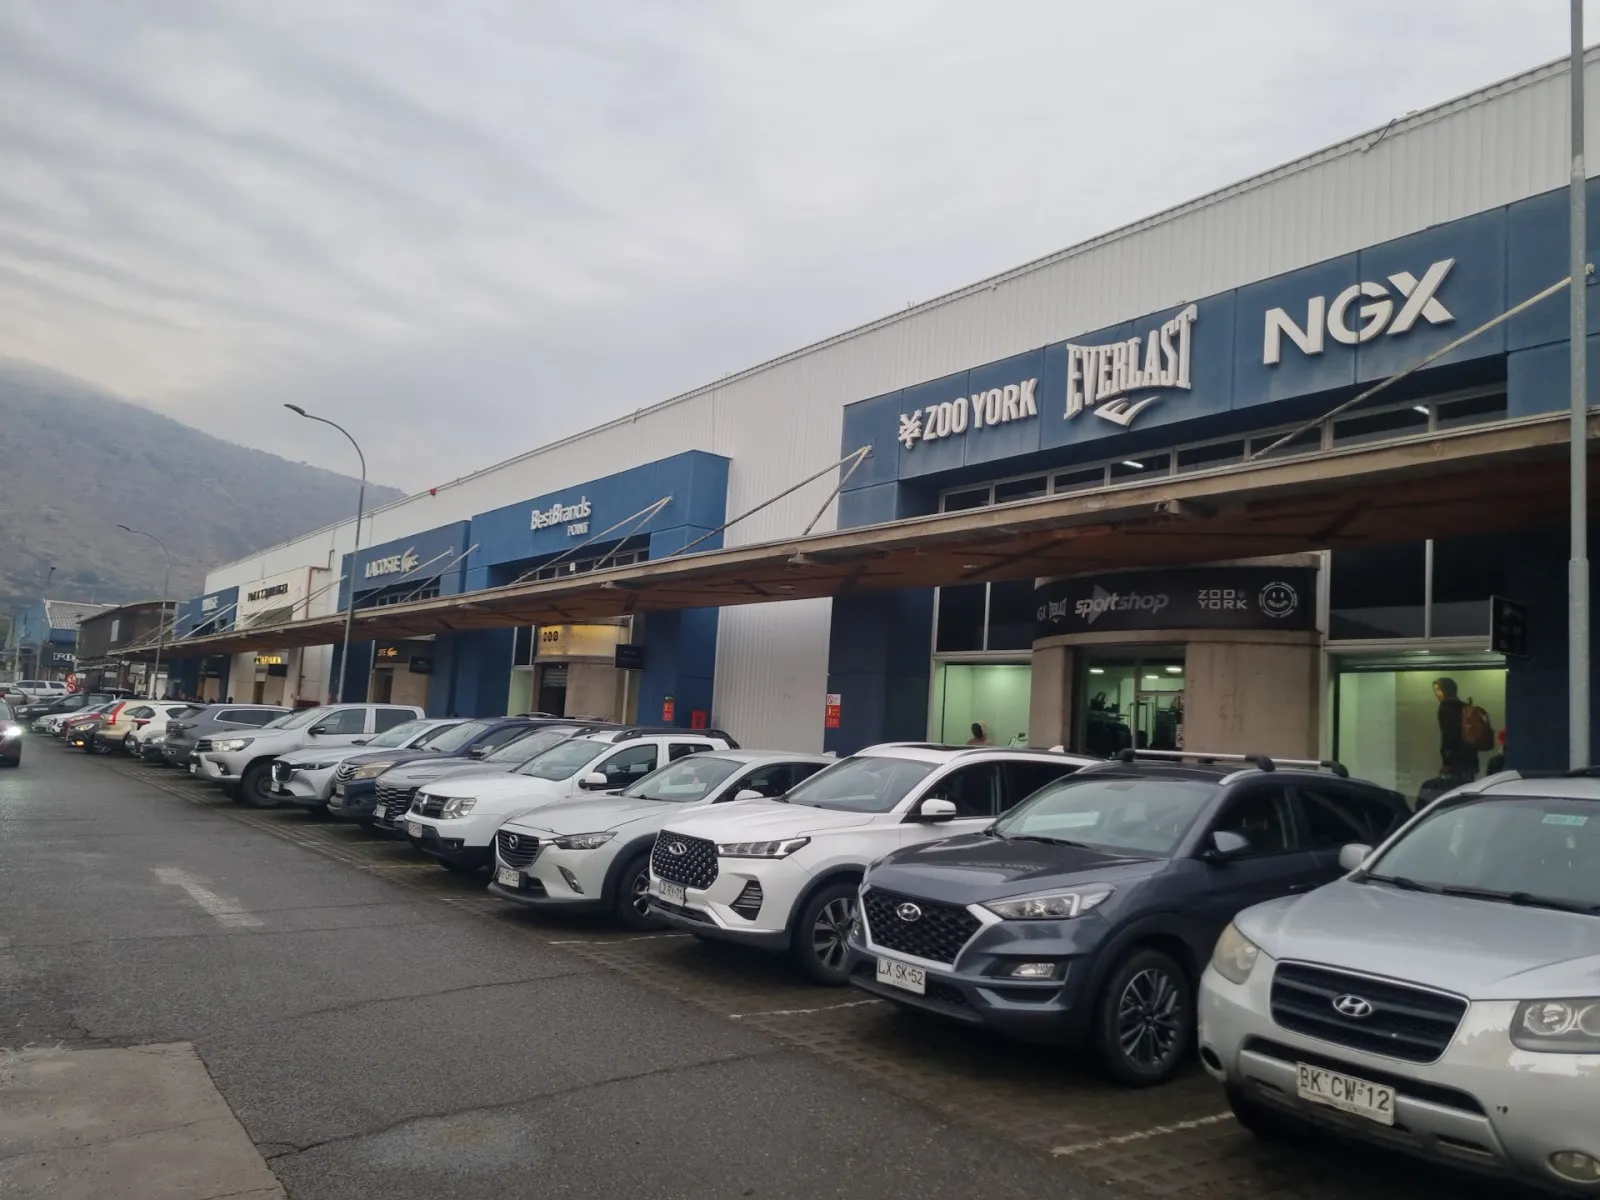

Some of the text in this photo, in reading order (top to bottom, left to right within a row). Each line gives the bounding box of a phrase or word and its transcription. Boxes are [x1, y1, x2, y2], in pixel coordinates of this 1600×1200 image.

[1263, 258, 1456, 364] NGX
[1064, 303, 1197, 420] EVERLAST
[923, 377, 1039, 441] ZOO YORK
[530, 495, 592, 530] BestBrands
[1075, 591, 1169, 618] sportshop
[1197, 589, 1236, 599] ZOO
[1197, 599, 1249, 610] YORK
